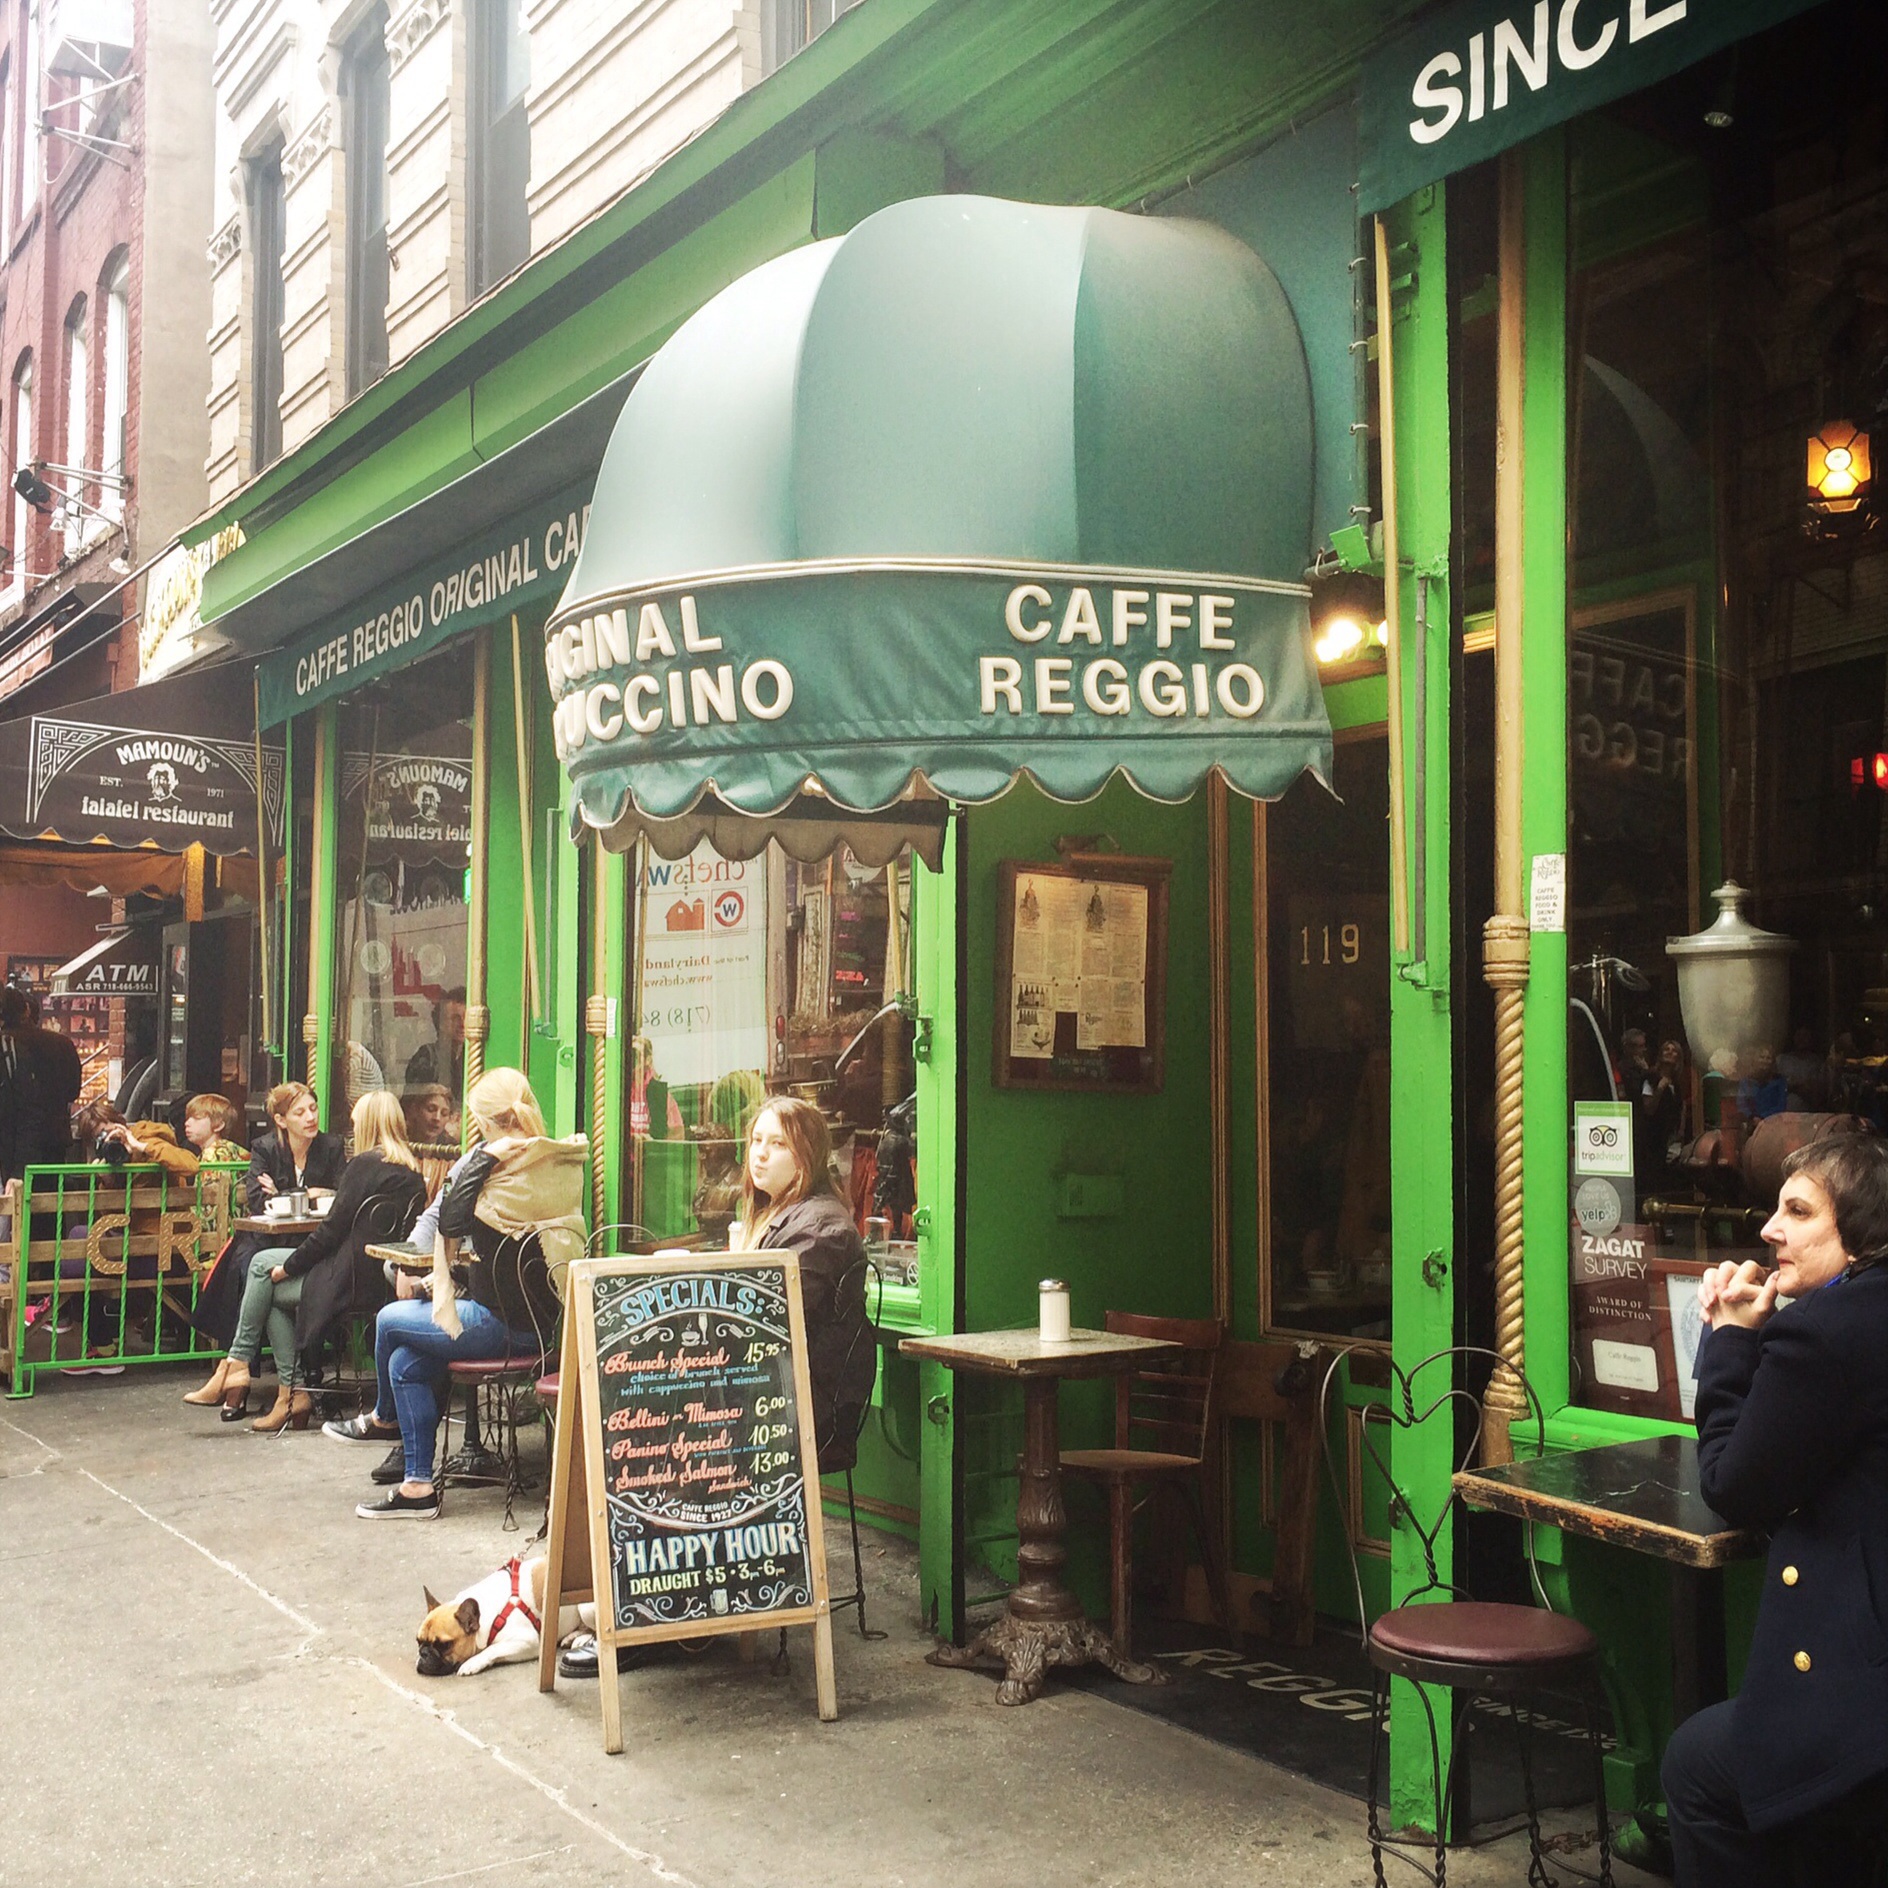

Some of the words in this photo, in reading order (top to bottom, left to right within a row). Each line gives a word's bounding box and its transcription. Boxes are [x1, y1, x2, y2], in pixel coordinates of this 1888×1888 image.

[296, 634, 349, 696] CAFFE
[353, 595, 424, 668] REGGIO
[430, 537, 538, 627] ORIGINAL
[1005, 584, 1235, 650] CAFFE
[979, 656, 1265, 718] REGGIO
[116, 740, 211, 773] MAMOUN'S
[99, 776, 123, 787] EST.
[206, 788, 224, 798] 1971
[81, 796, 140, 819] falafel
[143, 805, 234, 828] restaurant
[1300, 923, 1361, 965] 119
[85, 964, 149, 982] ATM
[75, 983, 101, 991] ASR
[1581, 1151, 1624, 1162] tripadvisor
[1581, 1208, 1606, 1222] yelp
[1581, 1236, 1645, 1259] ZAGAT
[1584, 1256, 1648, 1280] SURVEY
[620, 1280, 765, 1326] SPECIALS:
[1588, 1305, 1652, 1321] DISTINCTION
[1596, 1296, 1628, 1307] AWARD
[1630, 1299, 1643, 1309] OF
[605, 1351, 669, 1377] Brunch
[670, 1347, 730, 1378] Special
[630, 1370, 666, 1384] choice
[683, 1366, 720, 1378] brunch
[724, 1363, 759, 1375] served
[621, 1384, 644, 1397] with
[648, 1380, 705, 1396] cappuccino
[732, 1375, 771, 1386] mimosa
[607, 1406, 670, 1431] Bellini
[684, 1402, 743, 1424] Mimosa
[755, 1396, 786, 1417] 6.00
[671, 1429, 733, 1462] Special
[748, 1424, 787, 1450] 10.50
[615, 1464, 677, 1493] Smoked
[679, 1460, 738, 1487] Salmon
[749, 1451, 789, 1475] 13.00
[680, 1510, 708, 1523] SINCE
[711, 1508, 732, 1523] 1927
[682, 1502, 703, 1512] CAFFE
[704, 1501, 728, 1513] REGGIO
[625, 1531, 719, 1575] HAPPY
[724, 1522, 800, 1563] HOUR
[629, 1570, 701, 1596] DRAUGHT
[705, 1566, 727, 1584] $5
